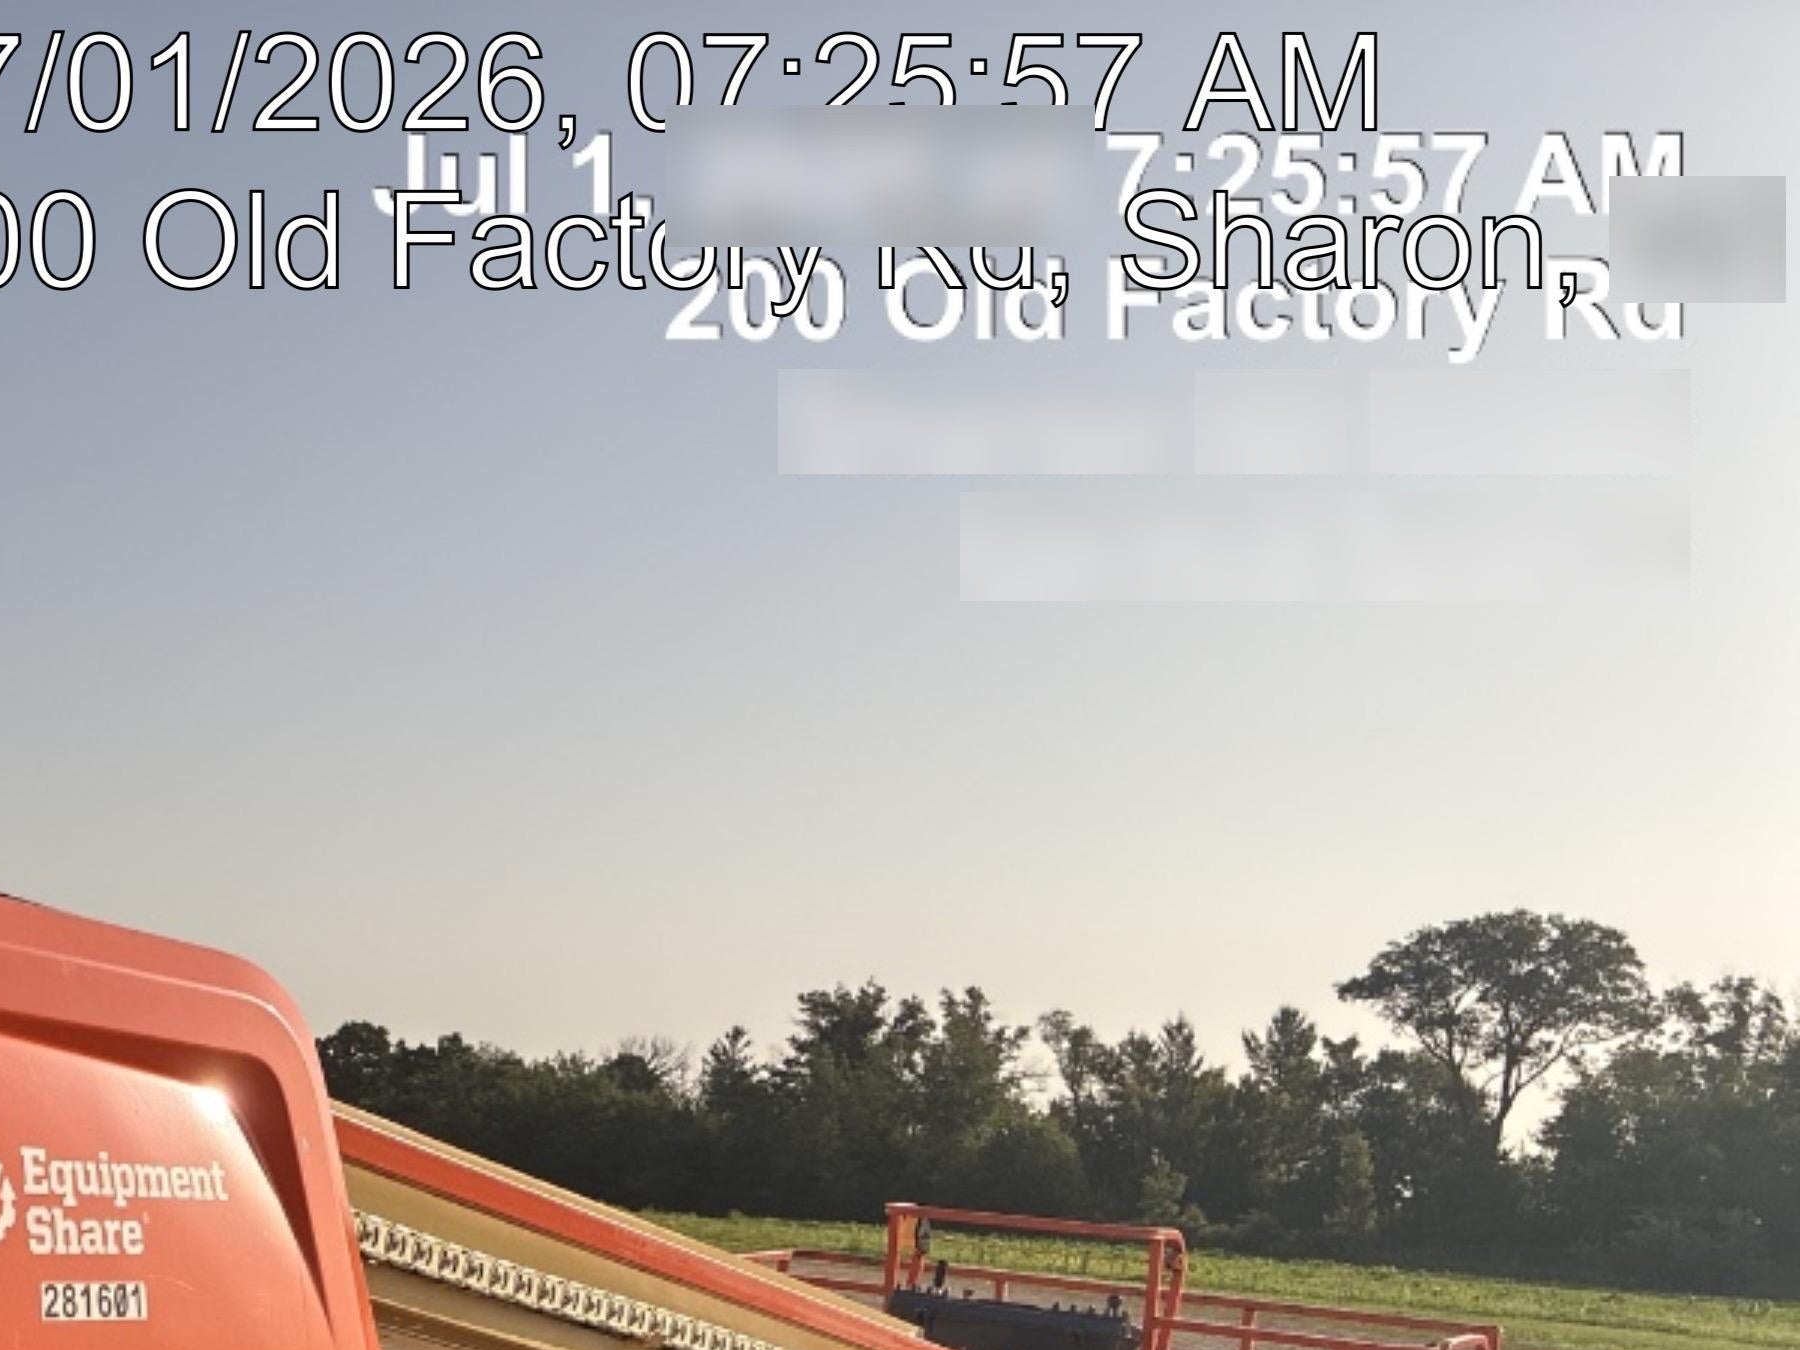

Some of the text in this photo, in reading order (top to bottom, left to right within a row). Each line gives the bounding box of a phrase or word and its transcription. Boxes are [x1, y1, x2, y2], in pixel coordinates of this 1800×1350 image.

[19, 1145, 229, 1208] Equipment
[26, 1205, 145, 1255] Share
[42, 1282, 143, 1318] 281601
